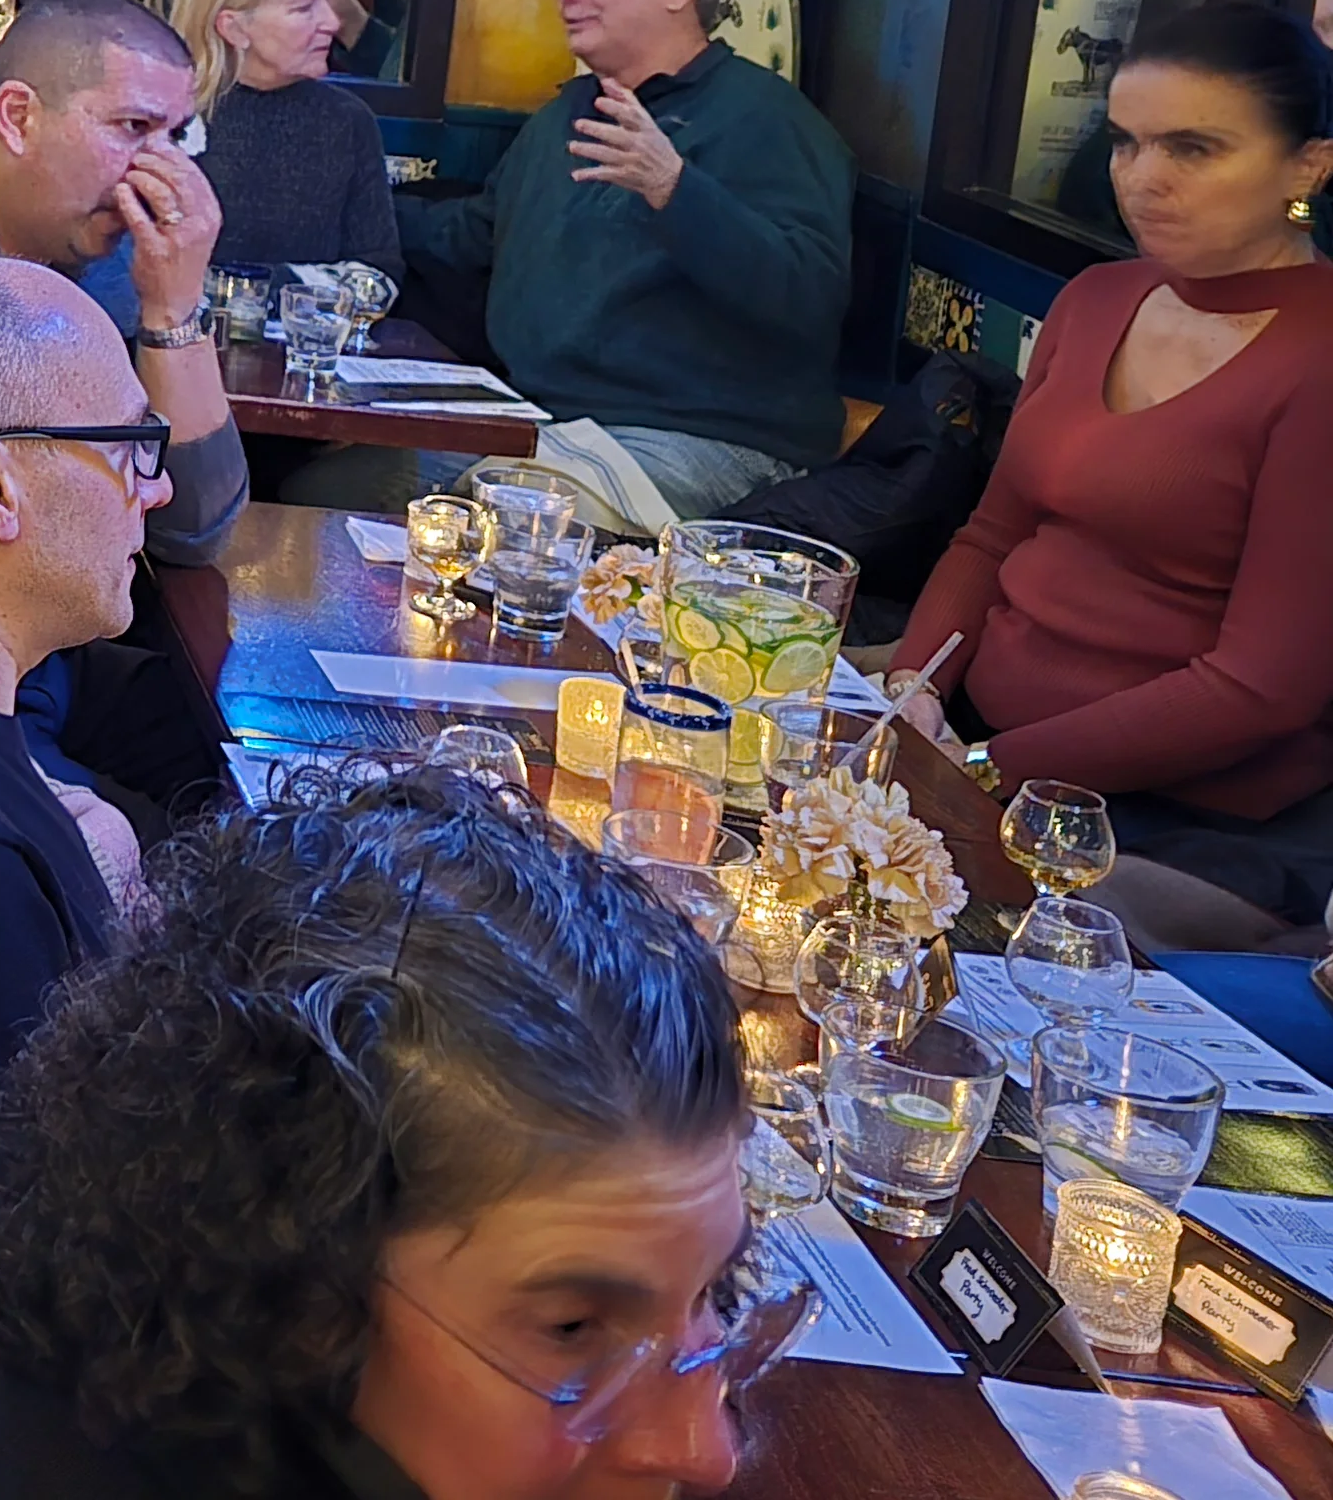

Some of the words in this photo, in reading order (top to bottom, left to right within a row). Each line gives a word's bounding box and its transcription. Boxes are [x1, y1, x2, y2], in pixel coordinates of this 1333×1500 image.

[959, 1256, 978, 1281] Fred
[981, 1248, 1018, 1291] WELCOME
[1197, 1274, 1222, 1298] Fred
[1222, 1263, 1285, 1308] WELCOME
[959, 1280, 985, 1320] Party
[1200, 1300, 1236, 1334] Party
